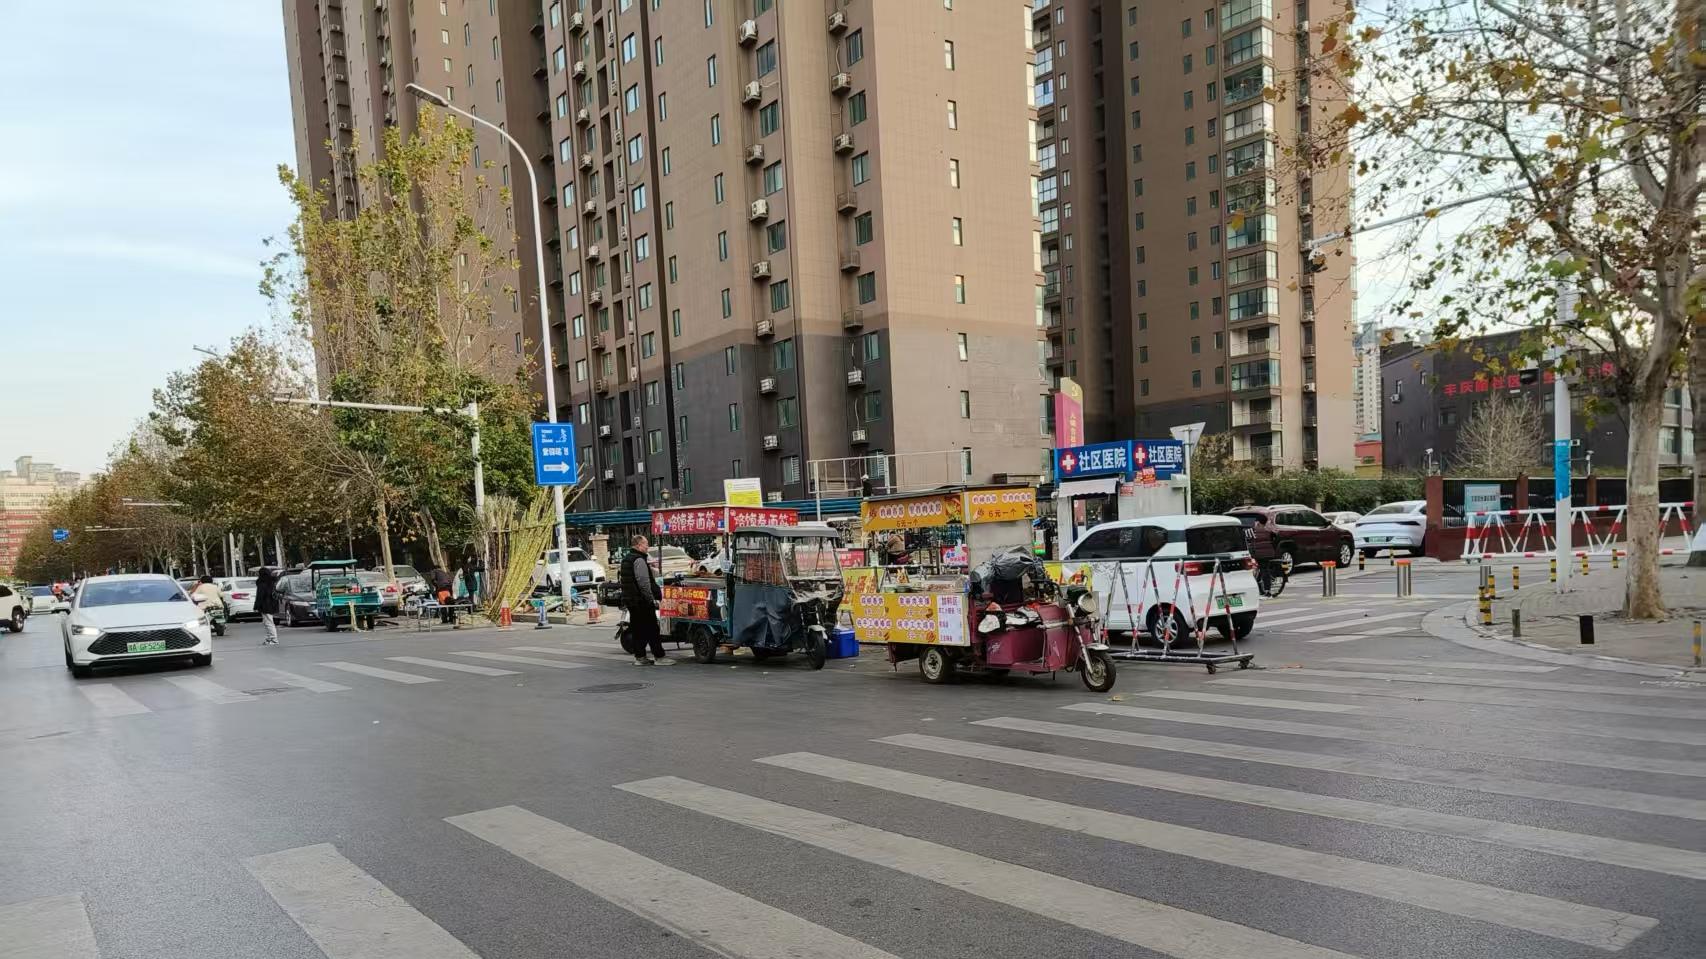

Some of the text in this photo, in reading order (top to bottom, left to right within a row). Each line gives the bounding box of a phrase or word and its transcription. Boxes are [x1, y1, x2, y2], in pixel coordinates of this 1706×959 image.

[1079, 446, 1127, 472] 社区医院
[1149, 445, 1183, 464] 社区医院
